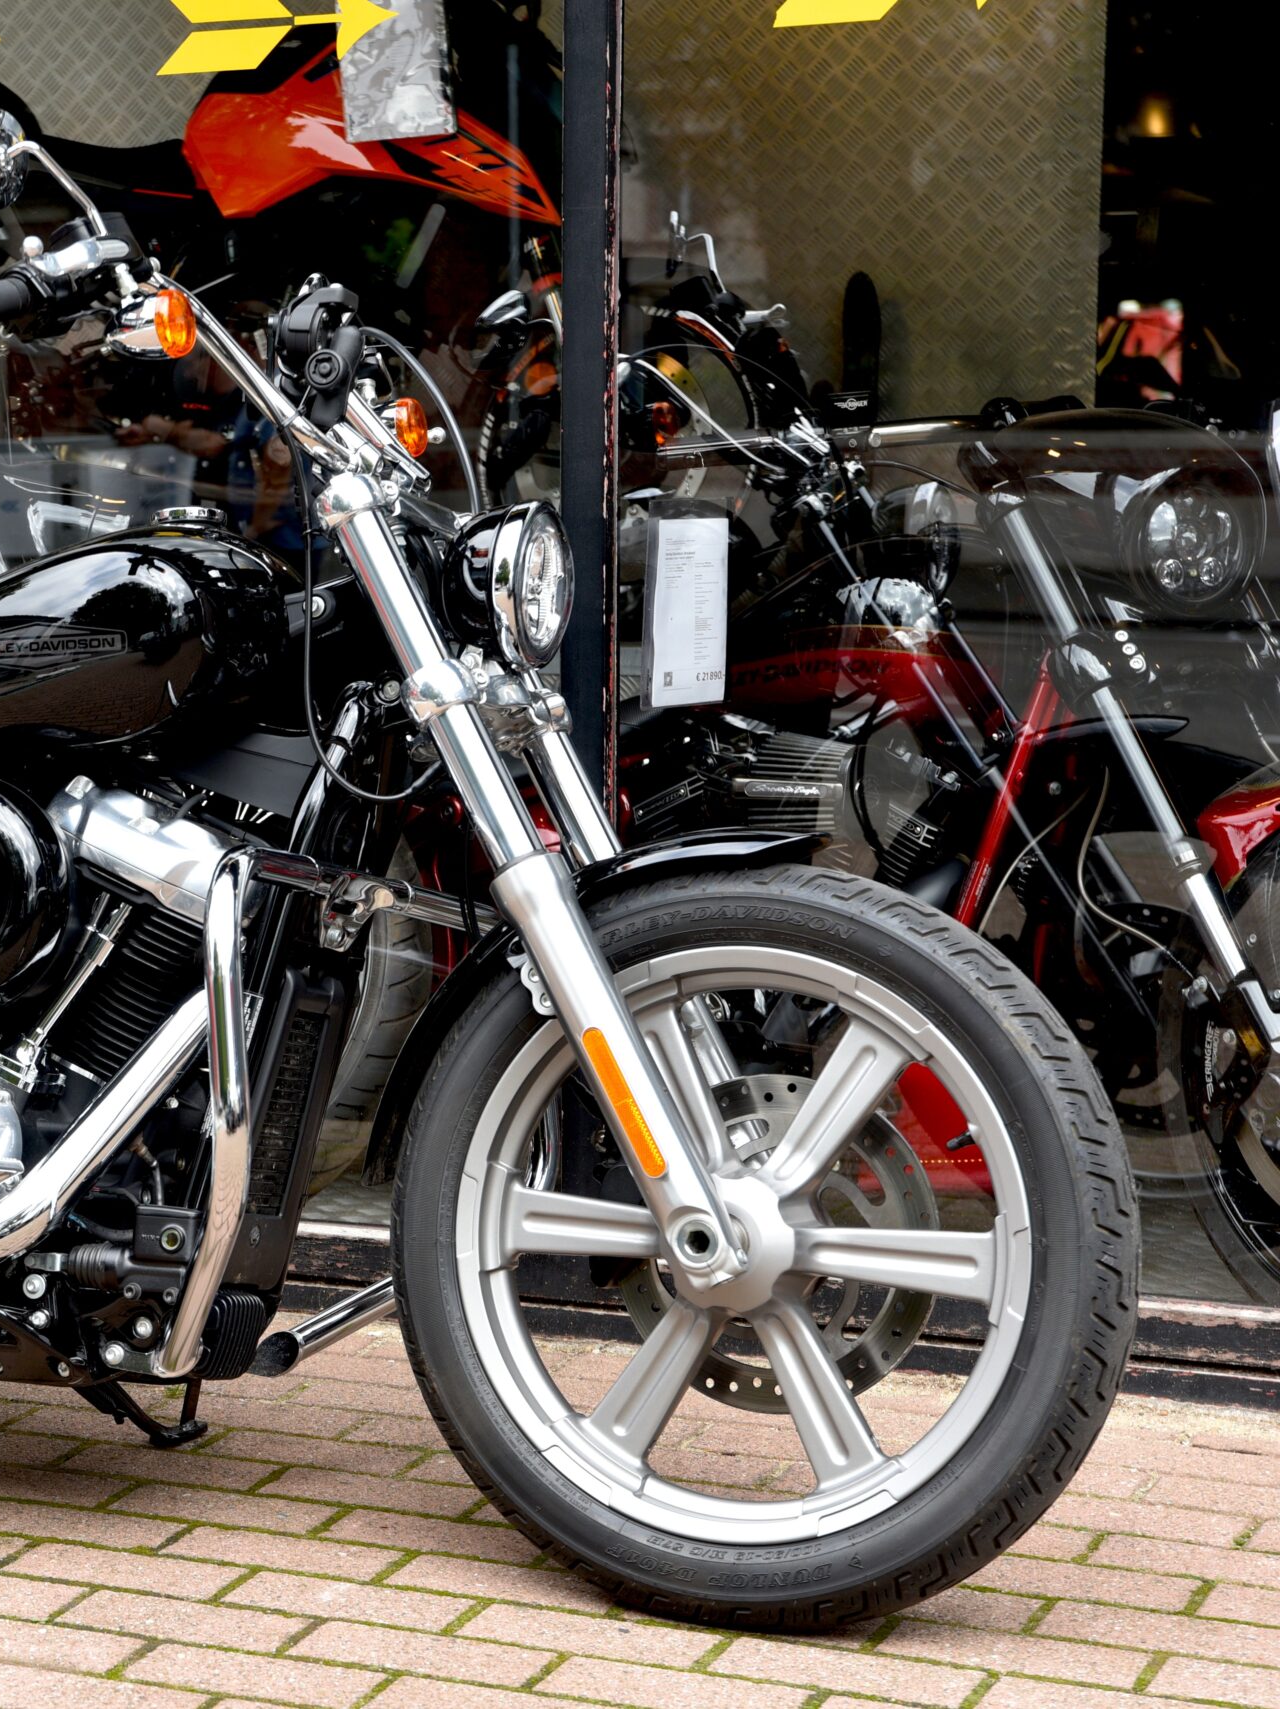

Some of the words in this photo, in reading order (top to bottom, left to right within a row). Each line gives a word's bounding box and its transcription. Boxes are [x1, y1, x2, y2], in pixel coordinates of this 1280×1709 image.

[600, 903, 858, 948] RLEY-DAVIDSON
[605, 1543, 697, 1582] D401F
[707, 1562, 833, 1590] DUNLOP
